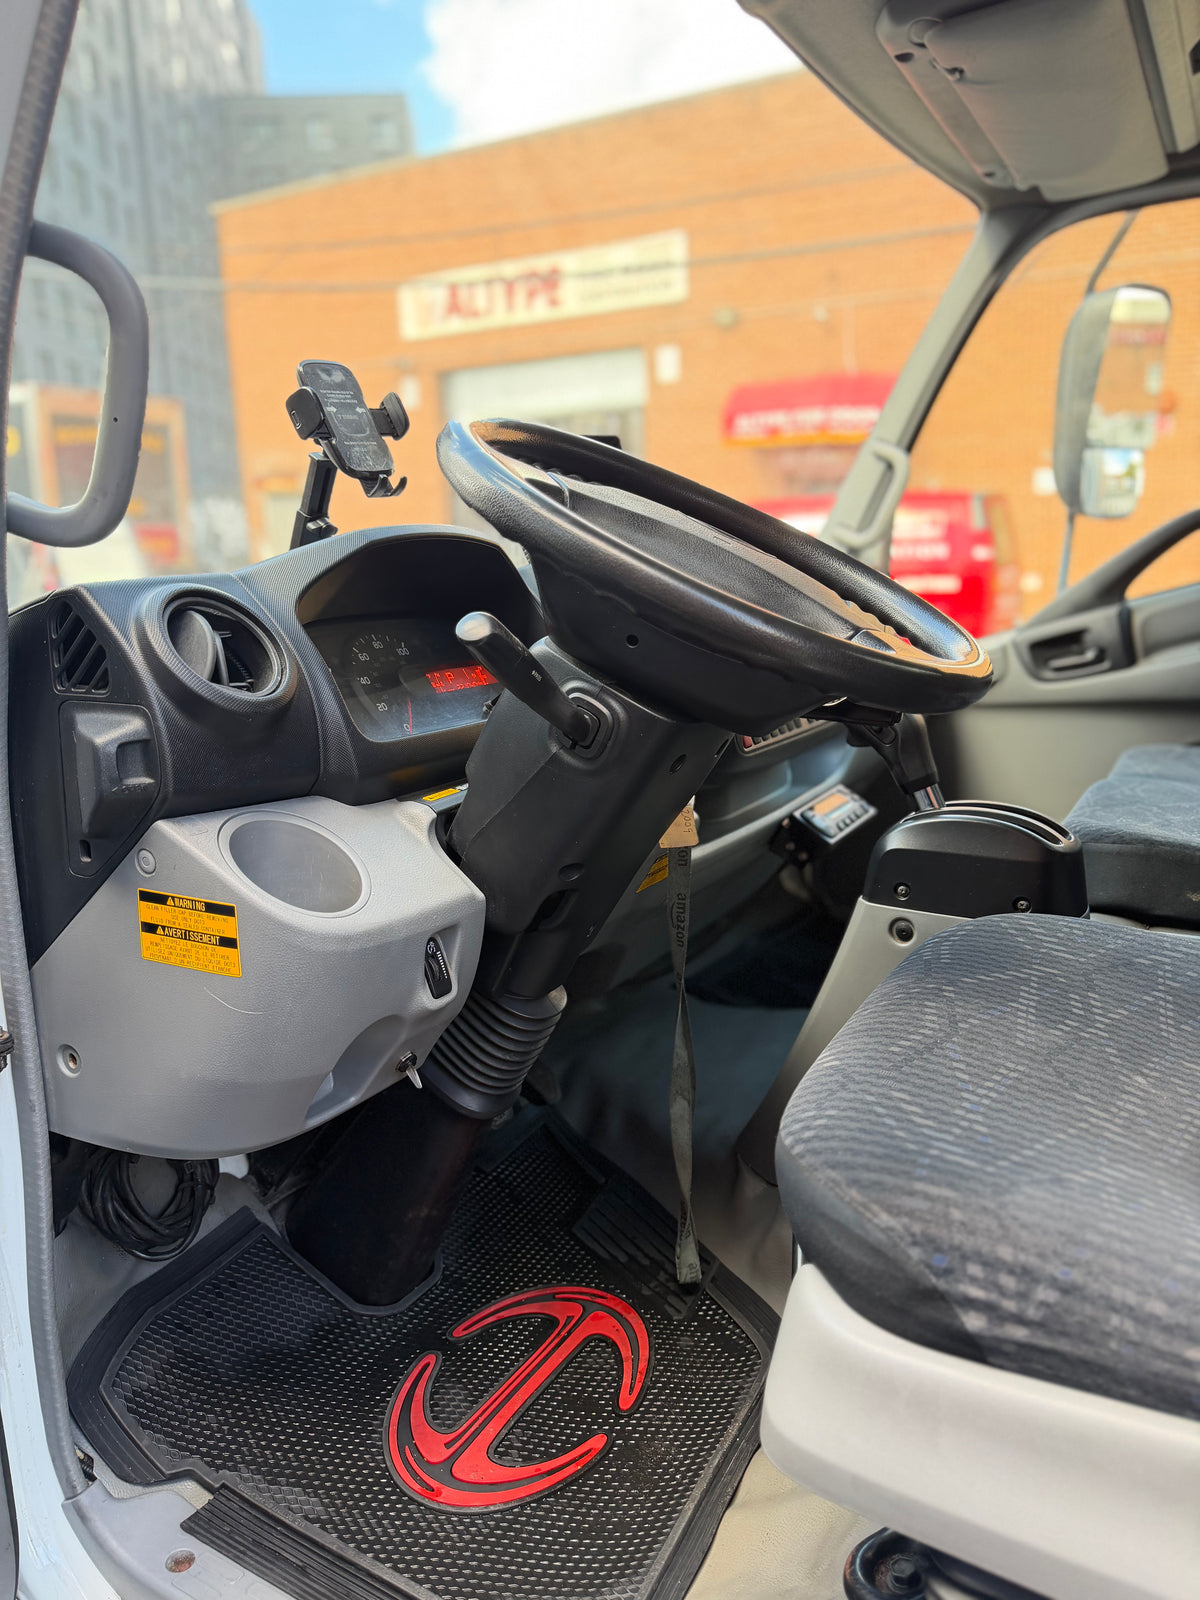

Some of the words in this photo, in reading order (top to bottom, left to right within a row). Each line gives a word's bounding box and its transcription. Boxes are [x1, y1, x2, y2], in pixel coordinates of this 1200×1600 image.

[372, 641, 384, 649] 80
[396, 647, 410, 656] 100
[358, 652, 370, 661] 60
[360, 676, 371, 685] 40
[376, 702, 388, 711] 20
[174, 898, 206, 912] WARNING
[676, 893, 687, 947] amazon
[164, 927, 220, 946] AVERTISSEMENT
